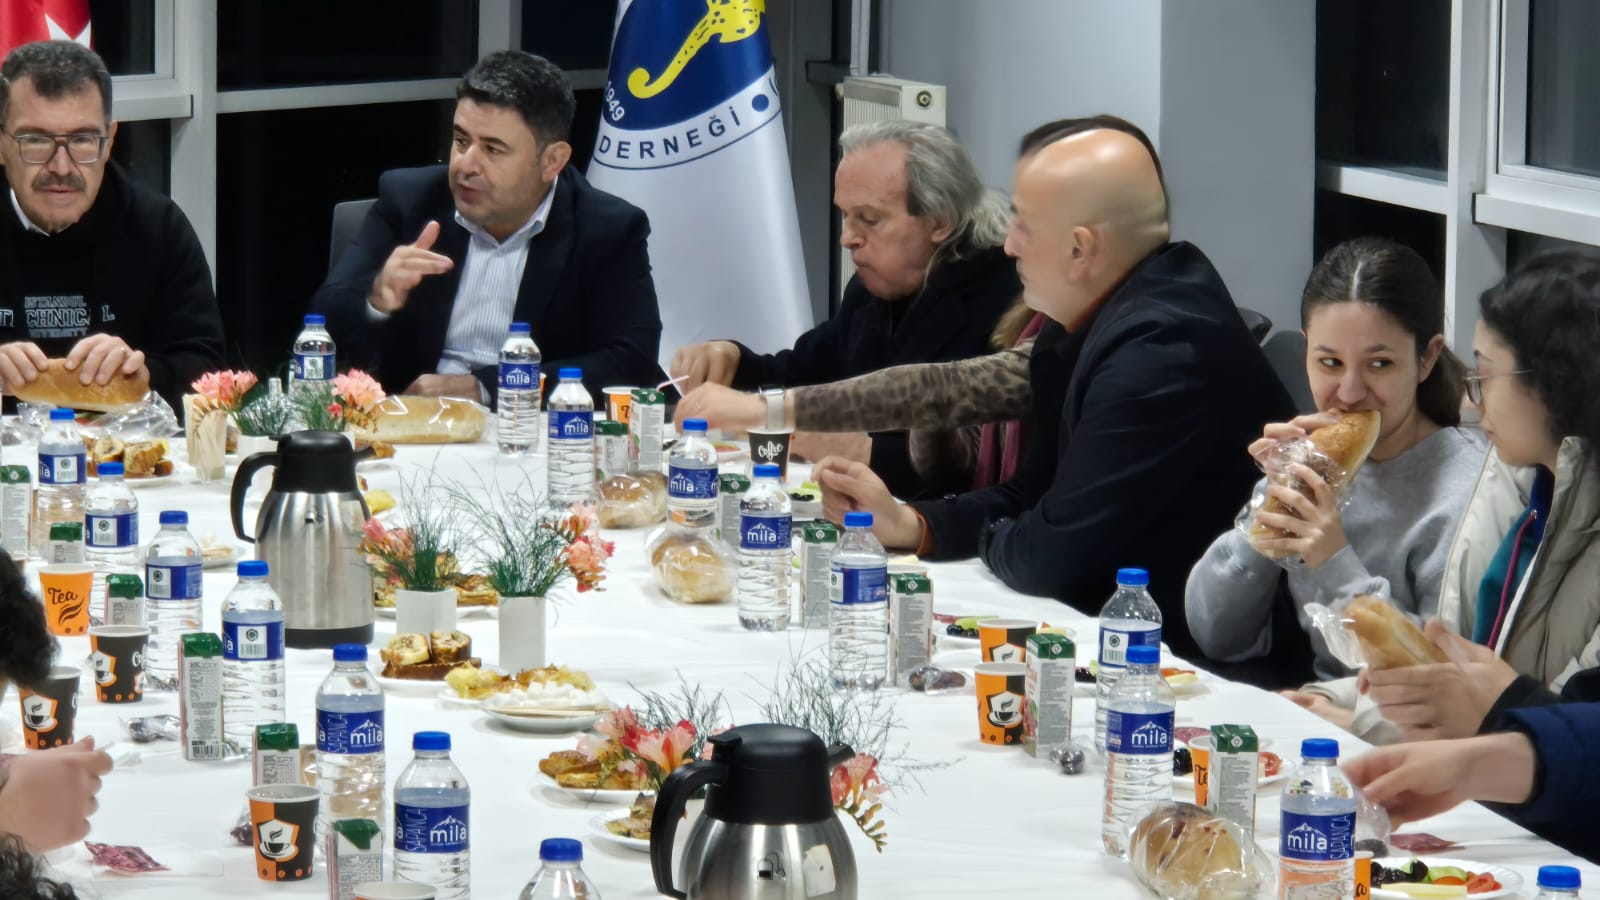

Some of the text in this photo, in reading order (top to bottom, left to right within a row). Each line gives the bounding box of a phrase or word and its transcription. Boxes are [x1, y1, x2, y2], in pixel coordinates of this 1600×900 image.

[598, 106, 741, 160] DERNEĞİ
[506, 374, 531, 384] mila
[564, 422, 589, 433] mila
[670, 480, 694, 492] mila
[747, 529, 777, 542] mila
[47, 587, 79, 605] Tea
[350, 729, 384, 745] mila
[1131, 730, 1168, 745] mila
[429, 824, 468, 843] mila
[1286, 832, 1329, 850] mila
